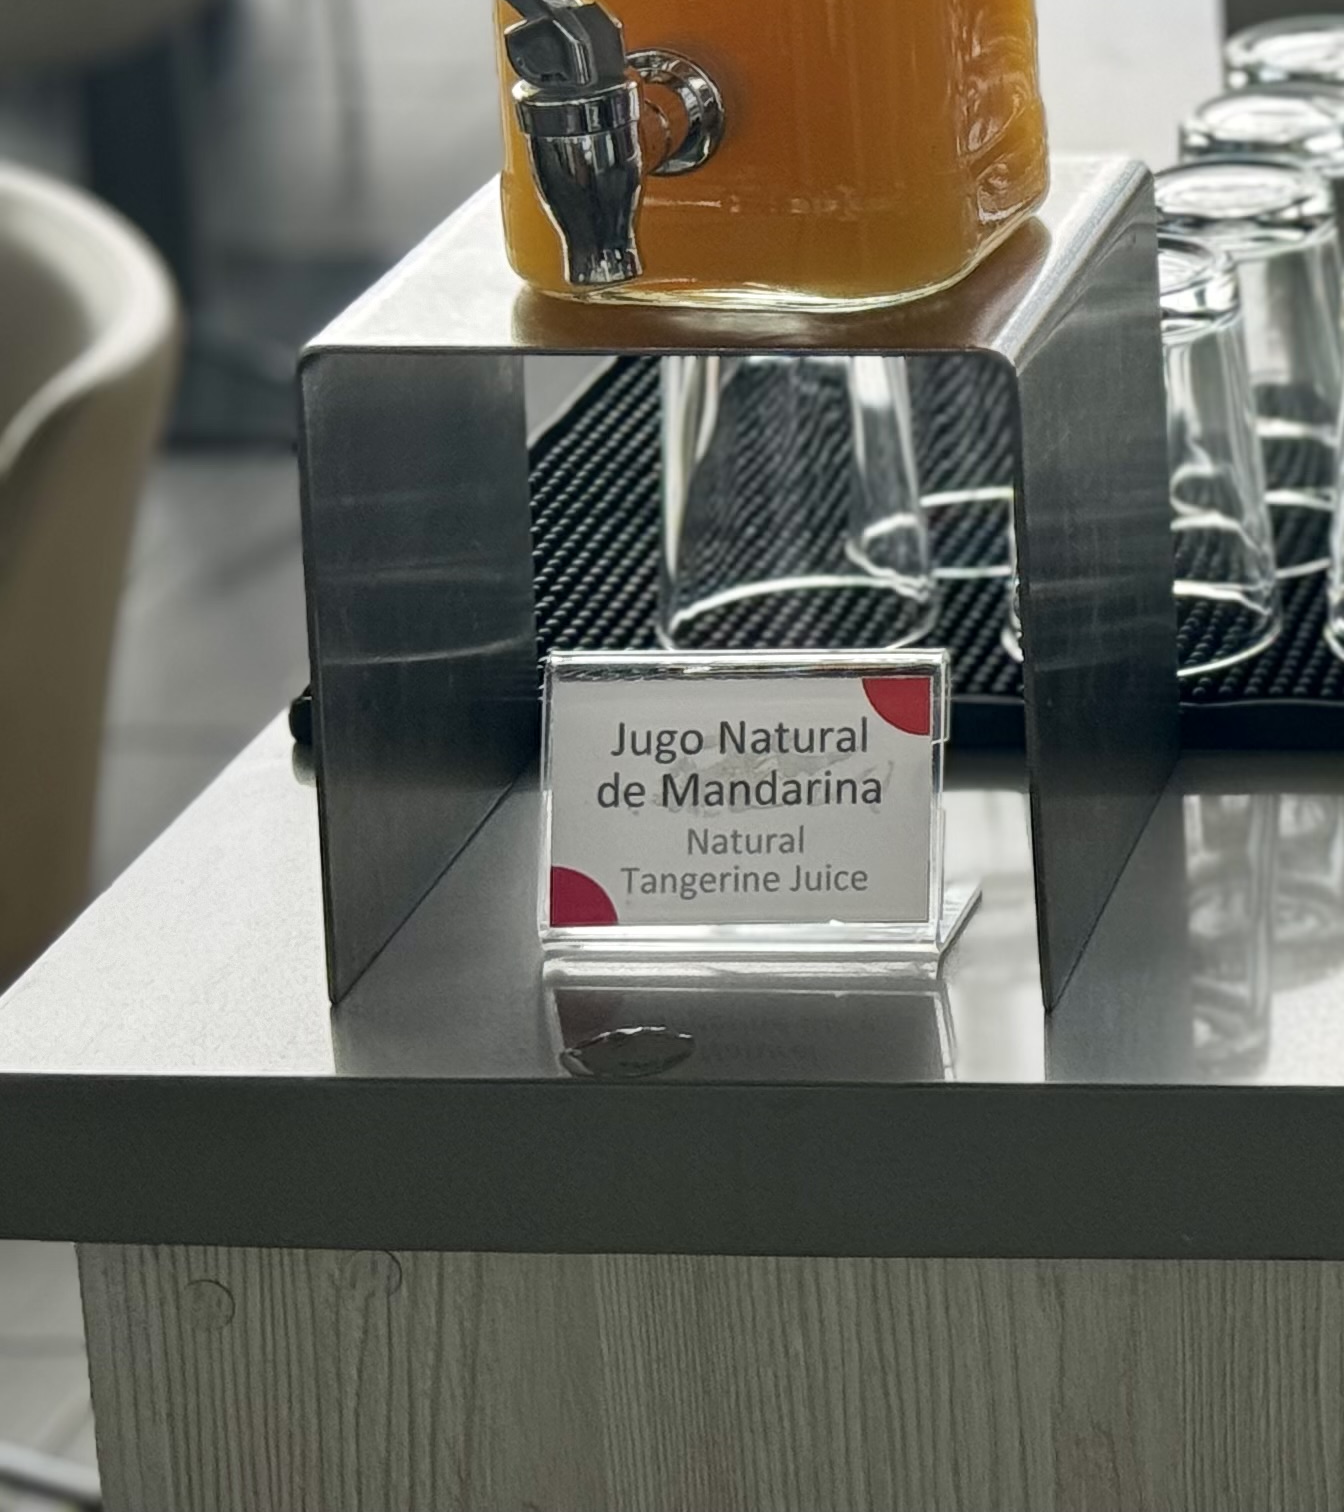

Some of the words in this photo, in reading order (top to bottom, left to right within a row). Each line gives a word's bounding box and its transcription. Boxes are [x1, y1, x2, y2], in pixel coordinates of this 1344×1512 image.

[611, 722, 703, 764] Jugo
[719, 717, 868, 755] Natural
[597, 772, 646, 808] de
[662, 770, 883, 807] Mandarina
[687, 826, 805, 855] Natural
[620, 866, 780, 900] Tangerine
[789, 864, 868, 893] Juice
